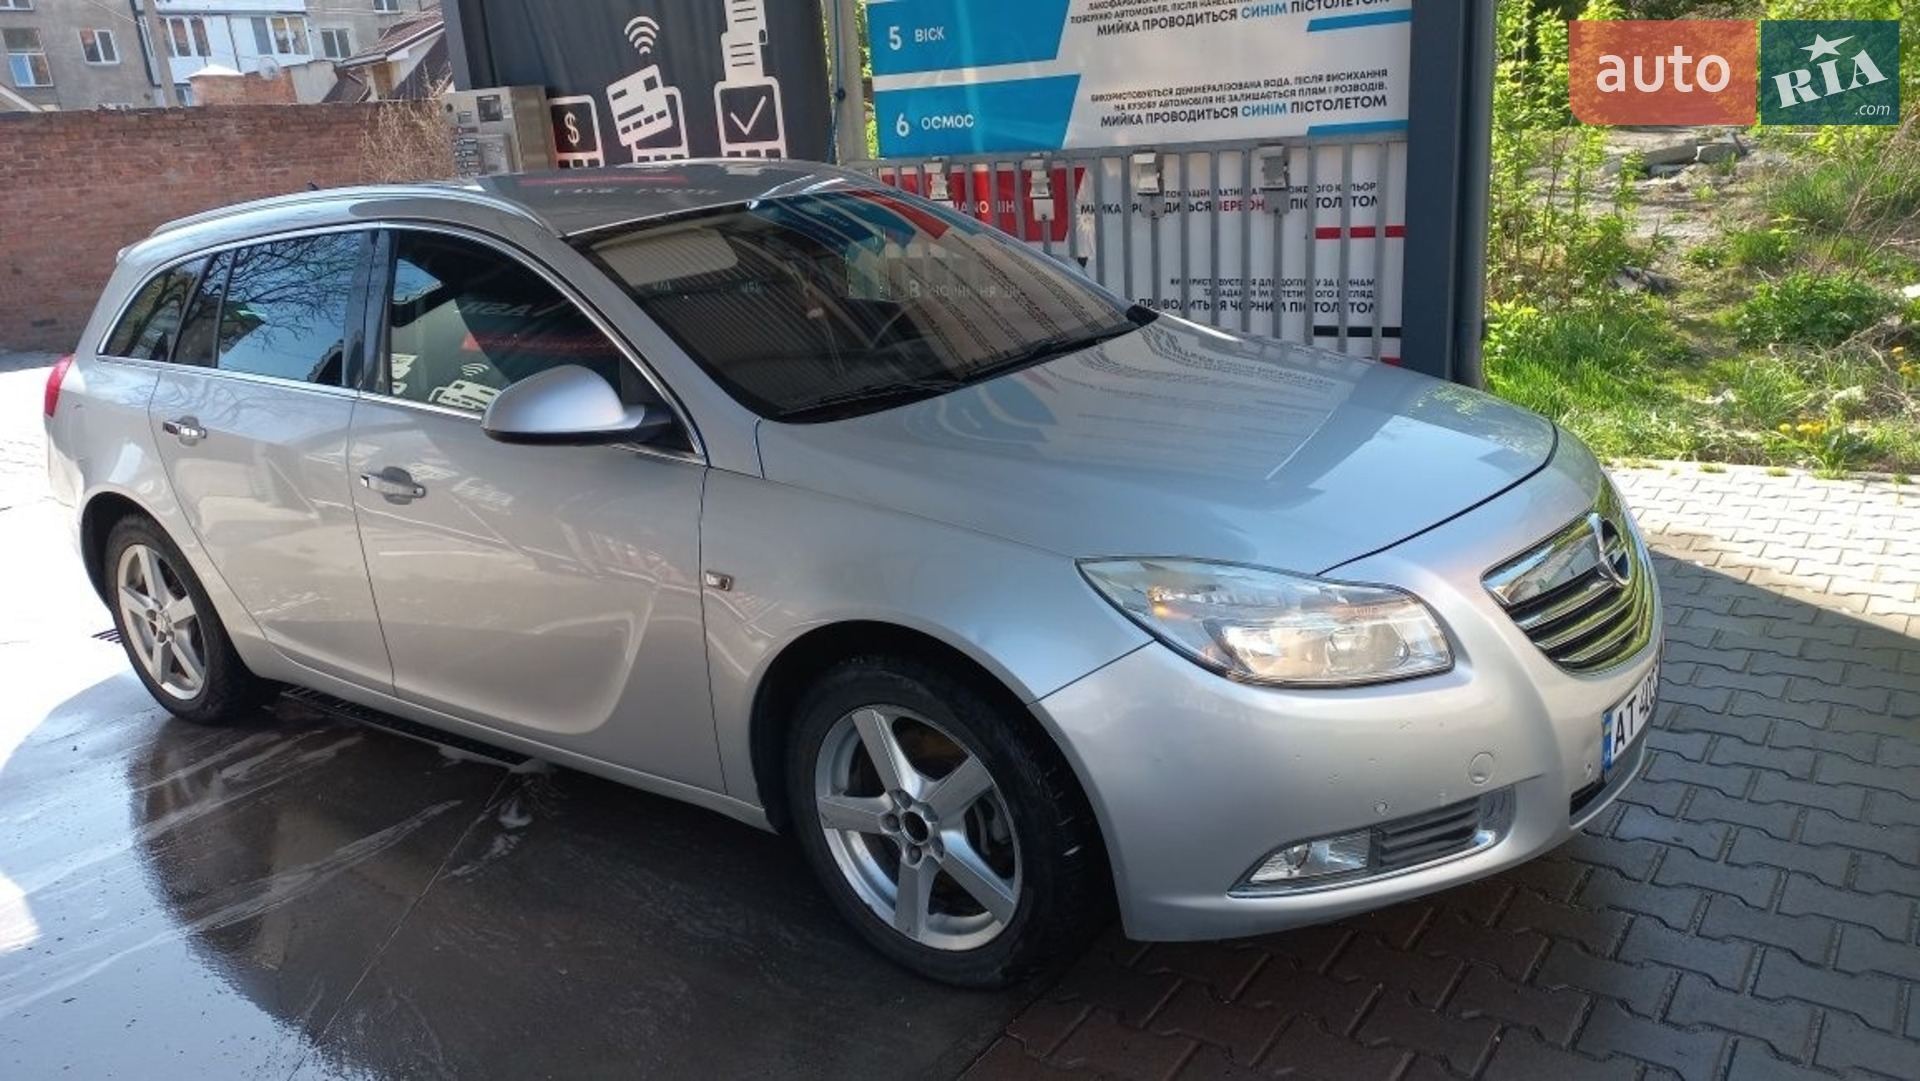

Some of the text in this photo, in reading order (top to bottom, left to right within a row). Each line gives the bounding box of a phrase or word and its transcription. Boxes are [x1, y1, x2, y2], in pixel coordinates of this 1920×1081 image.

[1097, 0, 1390, 36] МИЙКА ПРОВОДИТЬСЯ СИНІМ ПІСТОЛЕ
[1171, 1, 1198, 11] ПІСЛЯ
[889, 26, 945, 50] 5 ВІСК
[1091, 88, 1173, 102] ВИКОРИСТОВУЄТЬСЯ
[1175, 80, 1262, 96] ДЕМІНЕРАЛІЗОВАНА
[1294, 75, 1323, 86] ПІСЛЯ
[1326, 69, 1388, 82] ВИСИХАННЯ
[1101, 95, 1387, 127] МИЙКА ПРОВОДИТЬСЯ СИНІМ ПІСТОЛЕТОМ
[1114, 103, 1126, 112] НА
[1159, 96, 1213, 108] АВТОМОБІЛЯ
[1215, 94, 1226, 103] НЕ
[1228, 87, 1296, 103] ЗАЛИШАЄТЬСЯ
[1298, 86, 1326, 97] ПЛЯМ
[896, 113, 975, 137] 6 ОСМОС
[1290, 195, 1378, 209] ПІТОЛТО
[1290, 301, 1374, 313] ПІТОЛТО
